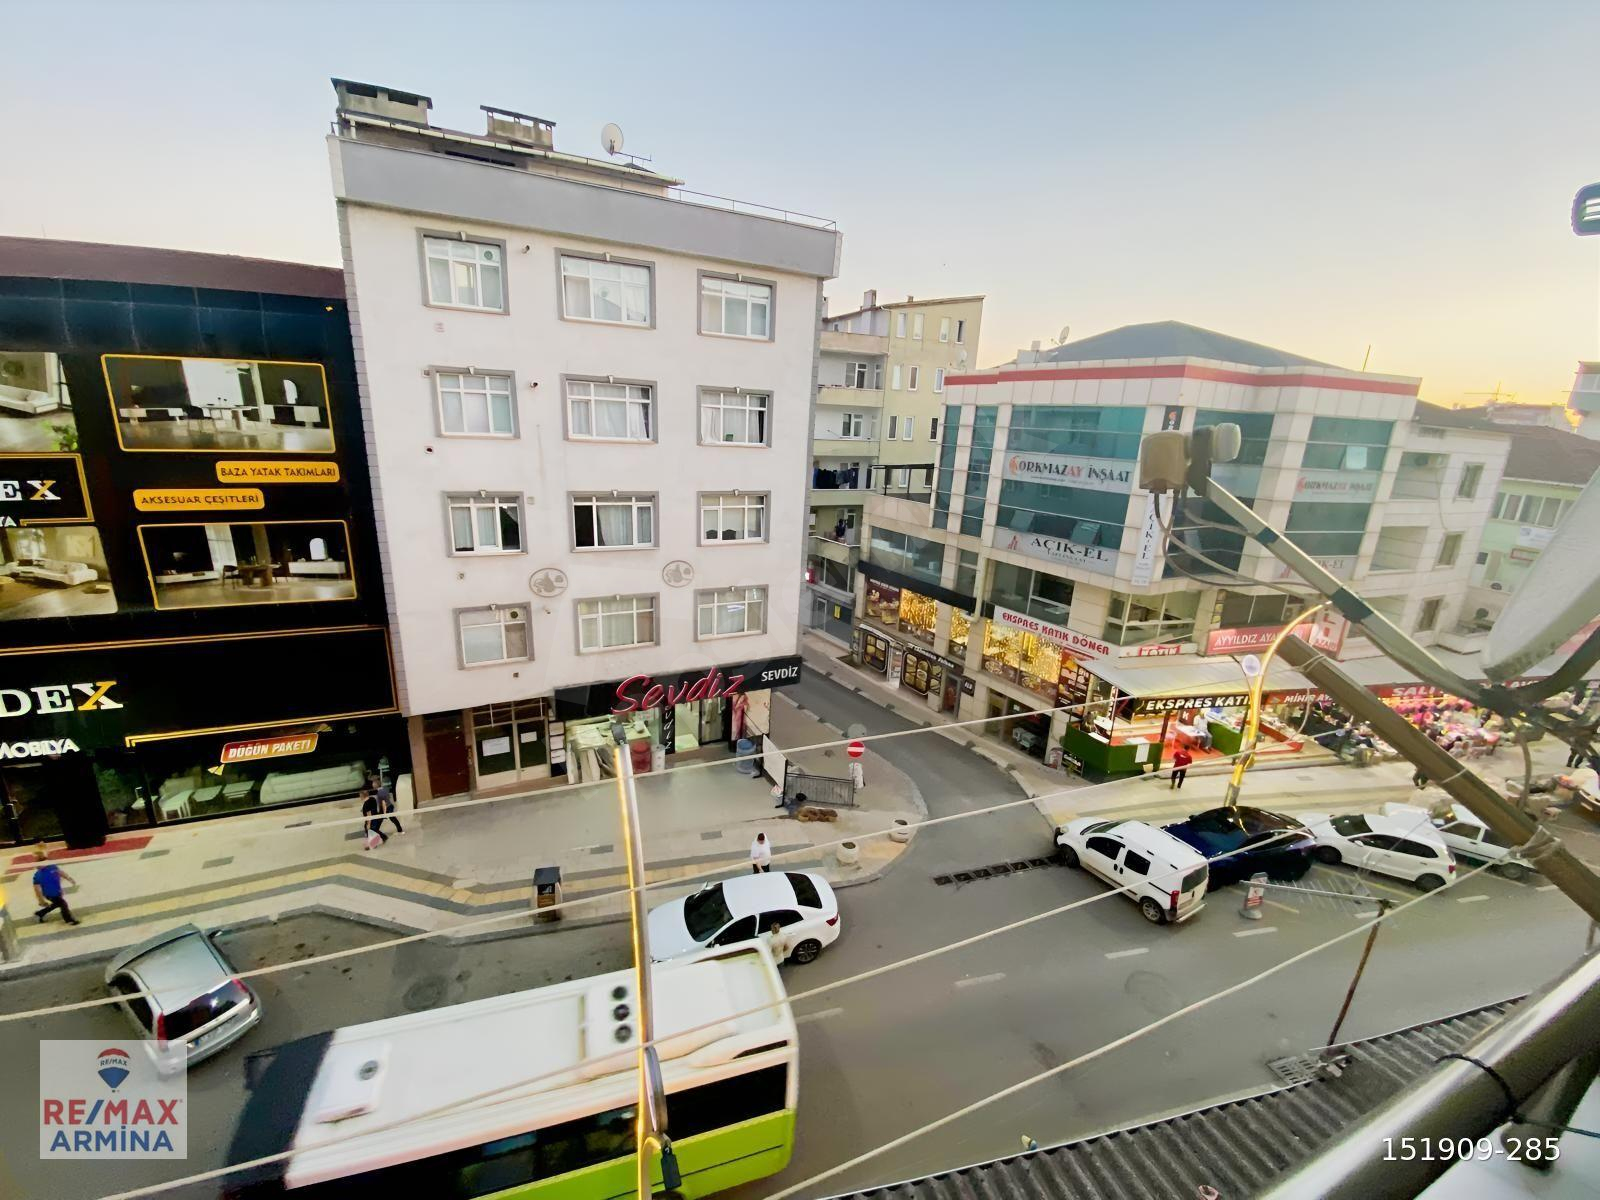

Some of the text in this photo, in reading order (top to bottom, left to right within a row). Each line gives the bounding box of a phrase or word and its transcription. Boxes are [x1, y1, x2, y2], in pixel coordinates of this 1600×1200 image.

[221, 467, 248, 477] BAZA
[250, 467, 282, 477] YATAK
[141, 496, 201, 505] AKSESUAR
[1072, 633, 1110, 656] DÖNER
[761, 665, 799, 682] SEVDİZ
[610, 665, 745, 713] Sevdiz
[1146, 695, 1250, 711] EKSPRES KATI
